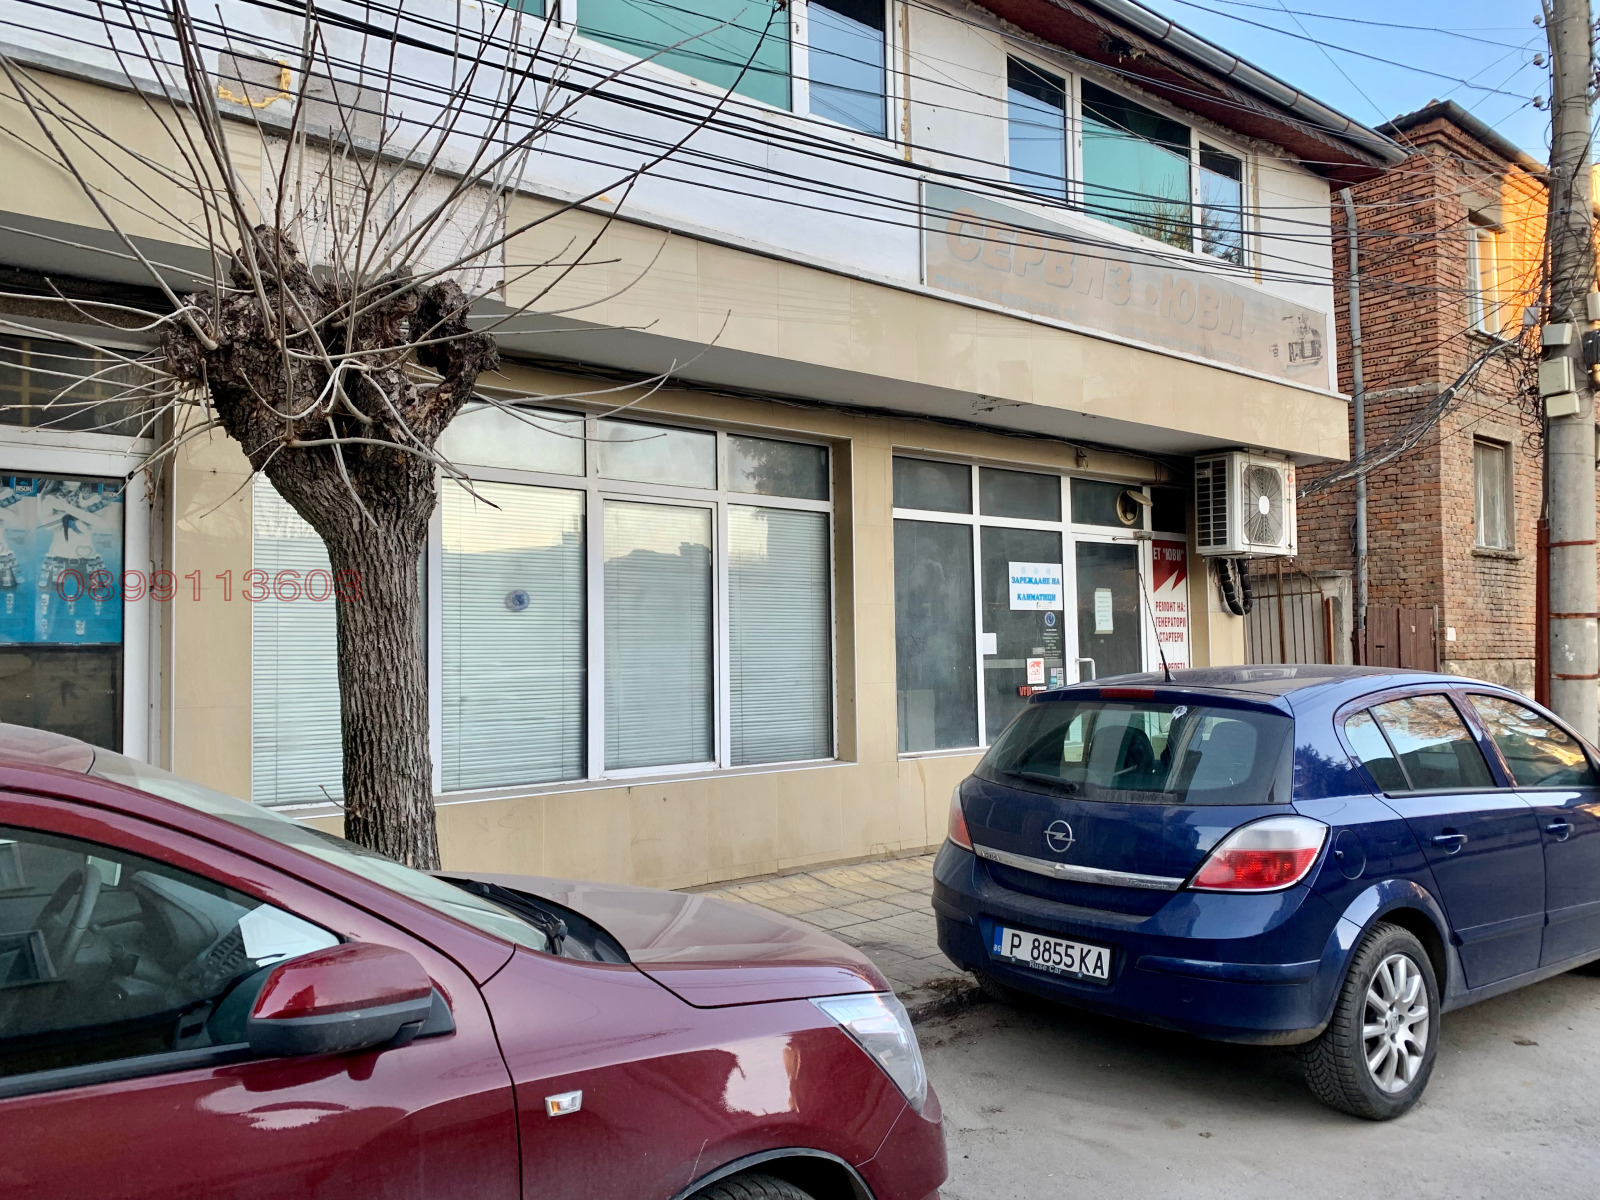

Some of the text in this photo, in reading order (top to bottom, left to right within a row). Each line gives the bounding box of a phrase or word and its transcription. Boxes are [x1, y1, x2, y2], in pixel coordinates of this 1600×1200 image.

[1152, 547, 1162, 561] ЕТ
[1011, 576, 1061, 586] ЗАРЕЖДАНЕ НА
[1016, 593, 1057, 602] КЛИМАТИЦИ
[1155, 601, 1176, 612] РЕМОНТ
[1155, 616, 1187, 628] ГЕНЕРАТОРИ
[1158, 631, 1184, 643] СТАРТЕРИ
[1010, 932, 1022, 956] P
[1029, 960, 1062, 975] Ruse Car
